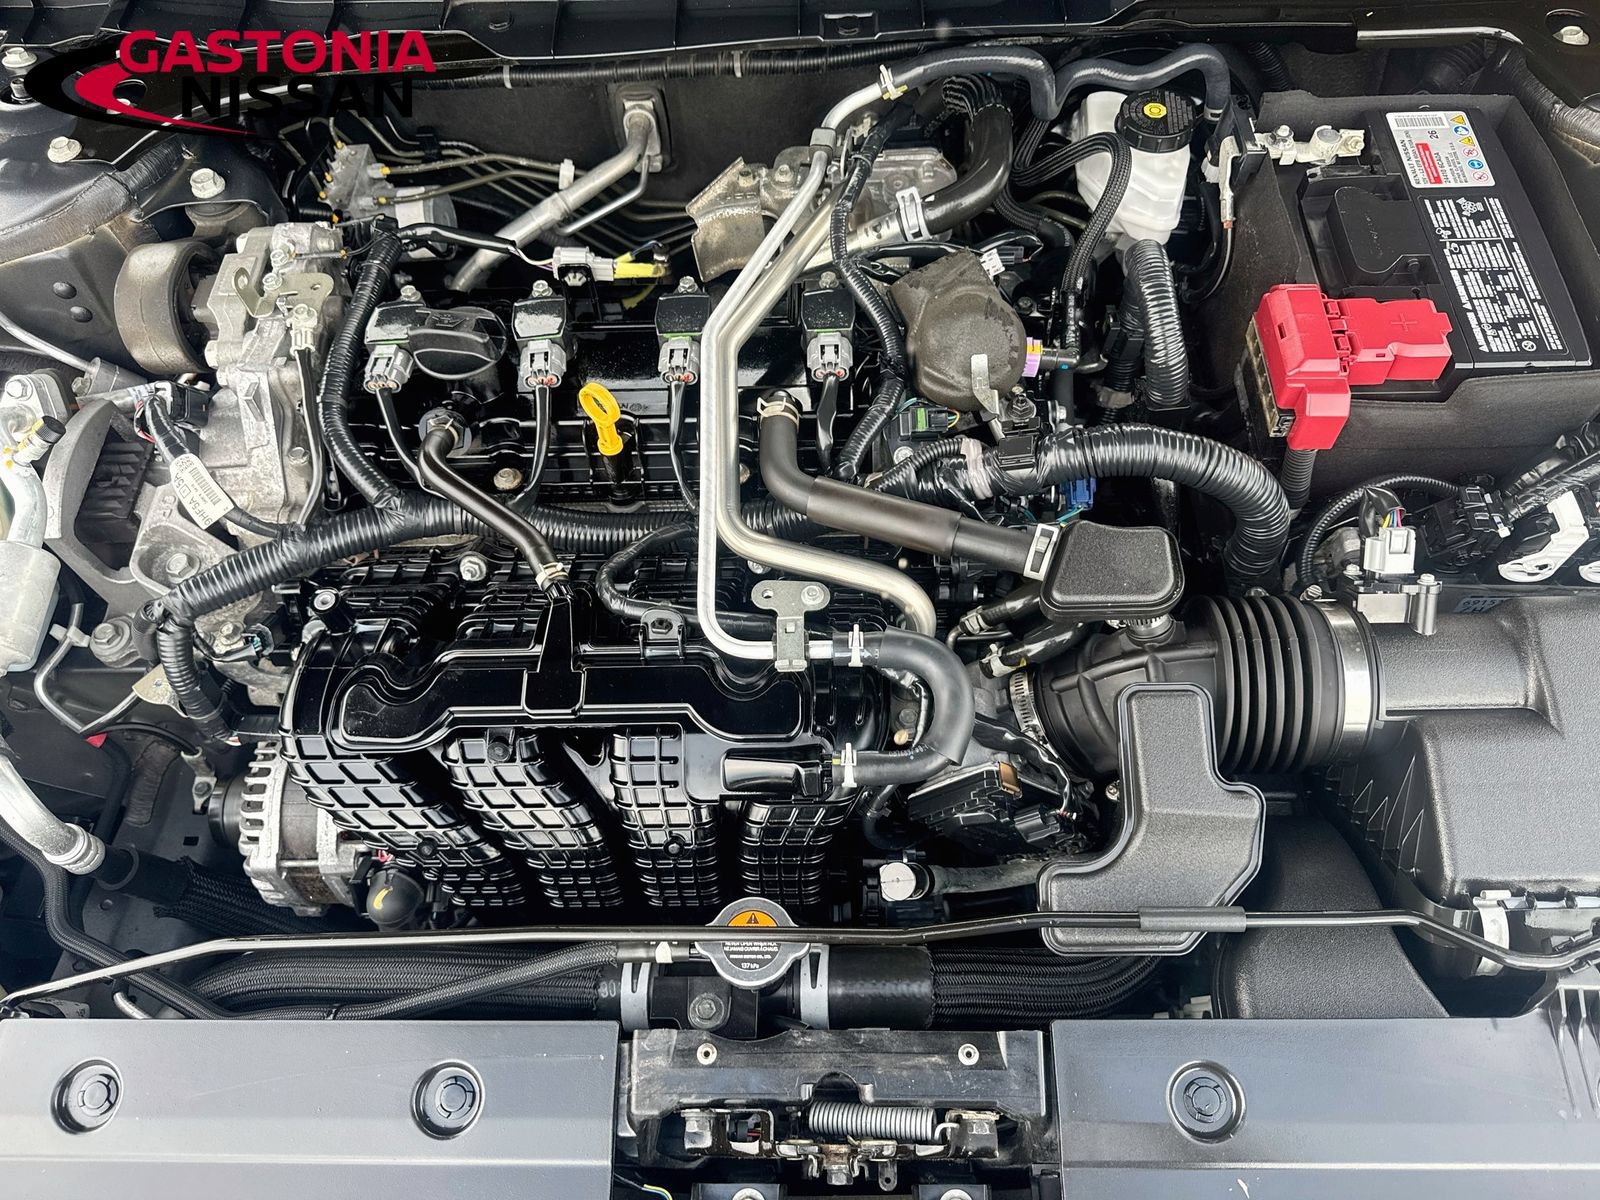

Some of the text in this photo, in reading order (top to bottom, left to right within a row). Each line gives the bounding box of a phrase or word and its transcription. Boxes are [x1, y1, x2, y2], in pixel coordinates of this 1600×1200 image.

[1427, 130, 1439, 139] 26
[1400, 139, 1421, 184] RENAULT NISSAN
[190, 496, 213, 525] 9HF5A
